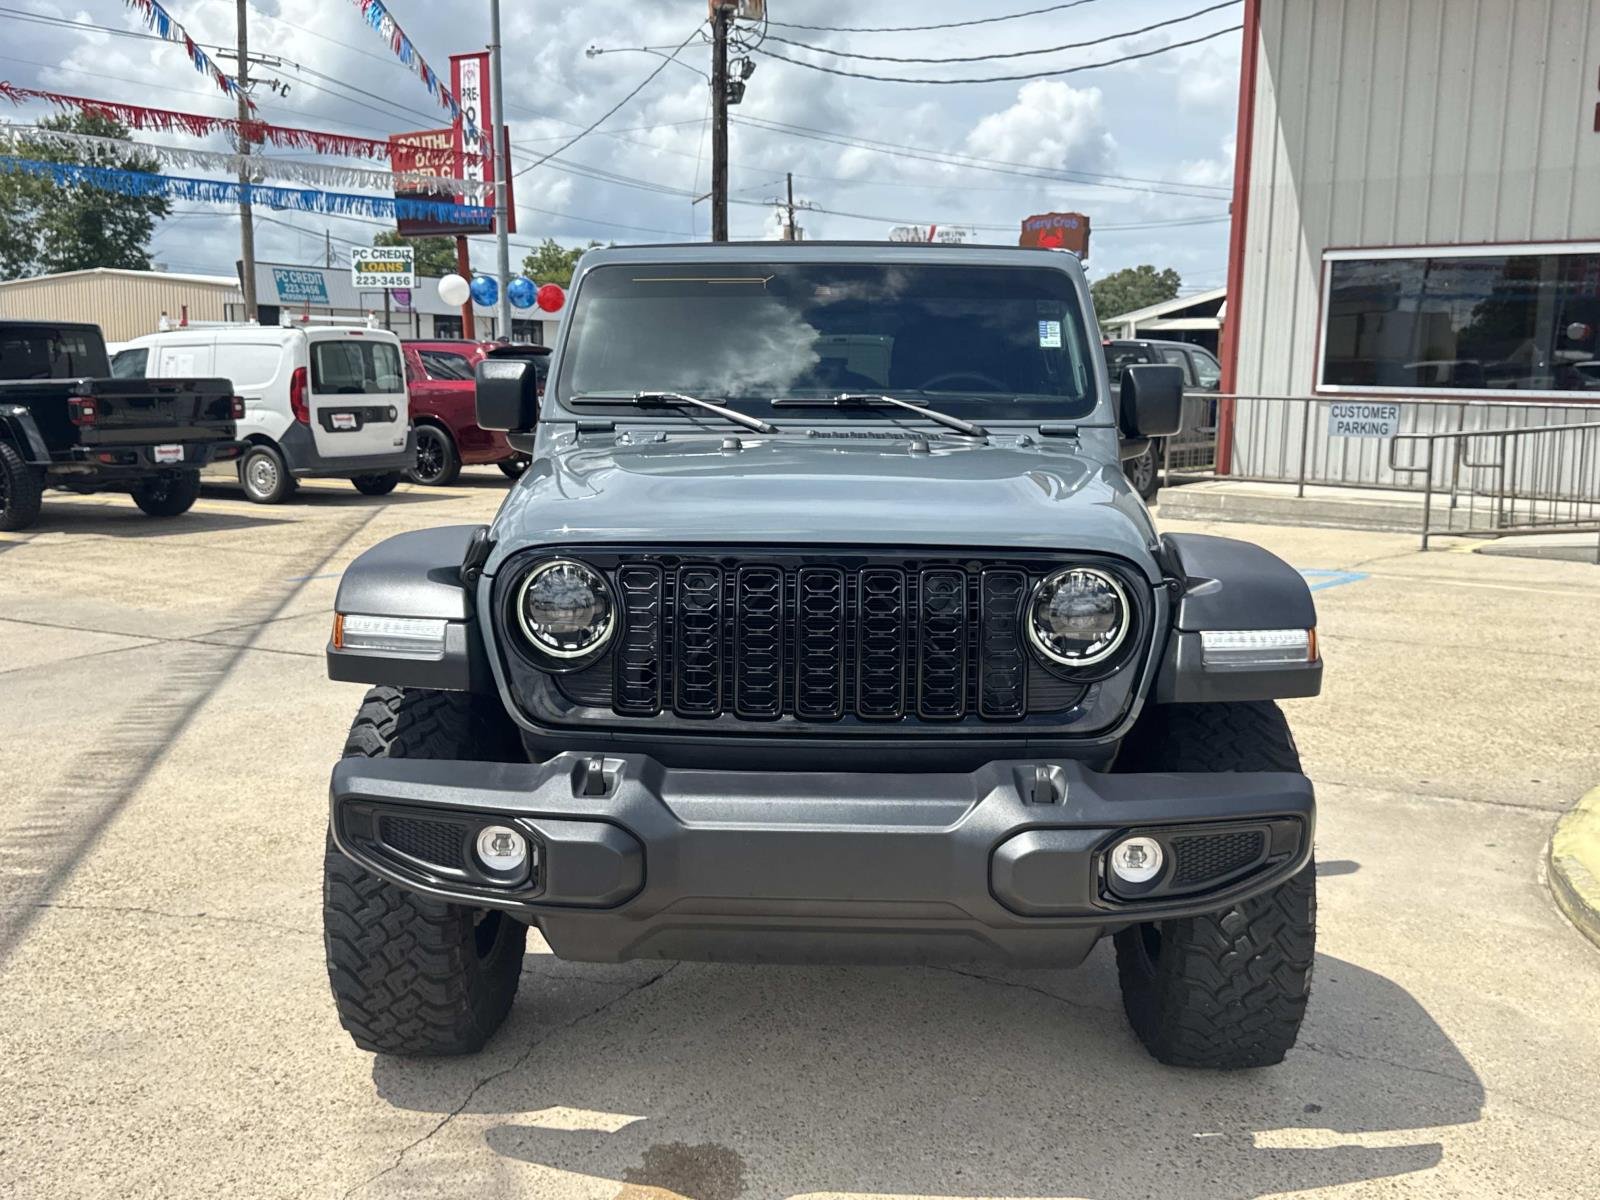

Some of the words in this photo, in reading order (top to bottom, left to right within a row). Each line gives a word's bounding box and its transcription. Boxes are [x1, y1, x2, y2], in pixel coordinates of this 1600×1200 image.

[352, 249, 368, 259] PC
[371, 249, 412, 259] CREDIT
[361, 262, 403, 272] LOANS
[274, 270, 288, 282] PC
[289, 271, 322, 286] CREDIT
[356, 276, 411, 286] 223-3456
[284, 283, 320, 295] 223-3456
[1331, 405, 1397, 419] CUSTOMER
[1336, 421, 1389, 435] PARKING
